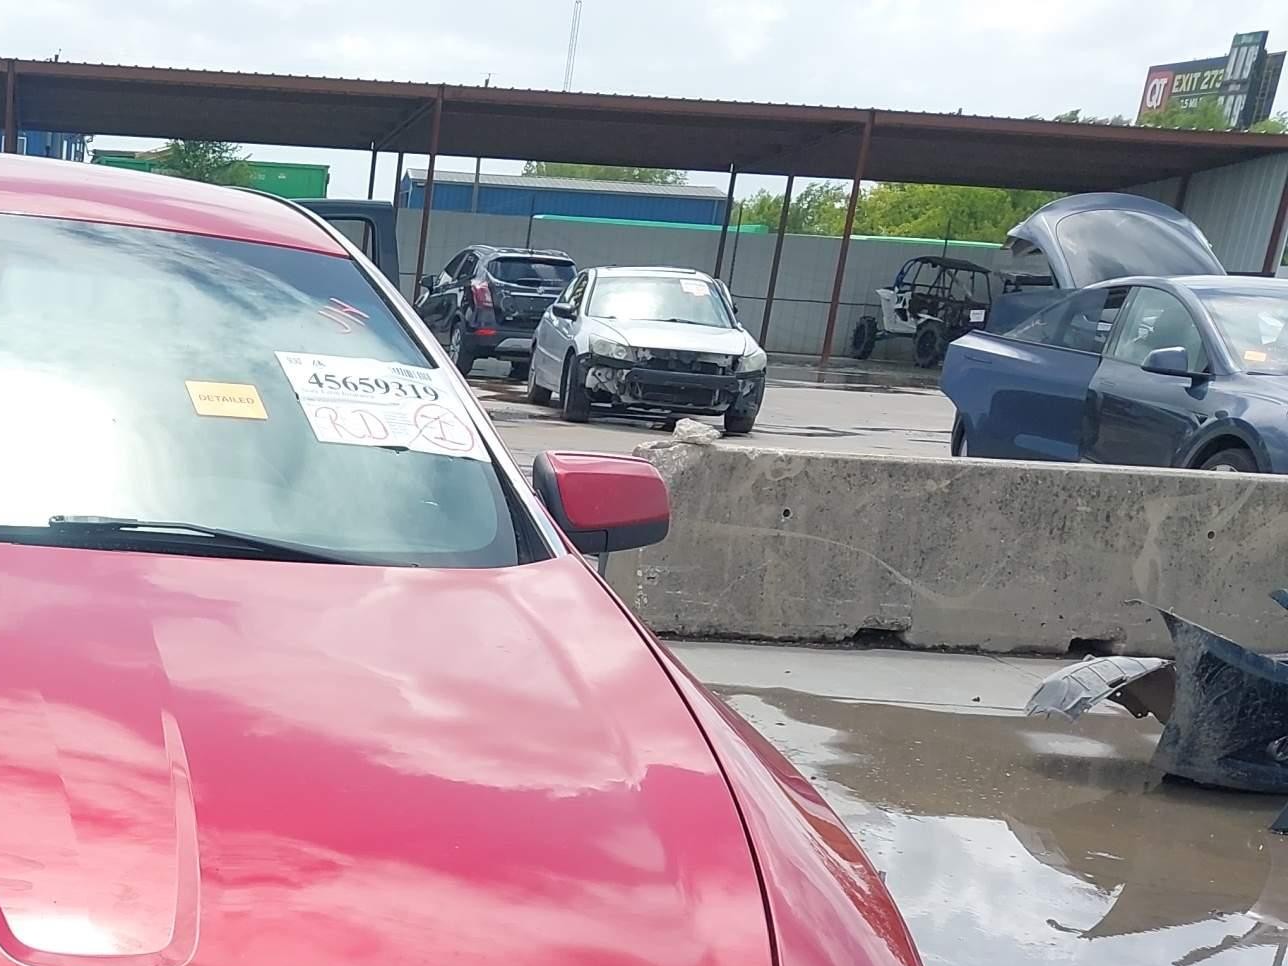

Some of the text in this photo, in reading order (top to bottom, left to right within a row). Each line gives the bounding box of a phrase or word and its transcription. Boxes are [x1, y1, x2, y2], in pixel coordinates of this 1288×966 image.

[1146, 78, 1168, 110] QT
[1171, 72, 1202, 93] EXIT
[198, 394, 255, 405] DETAILED
[308, 372, 439, 402] 45659319
